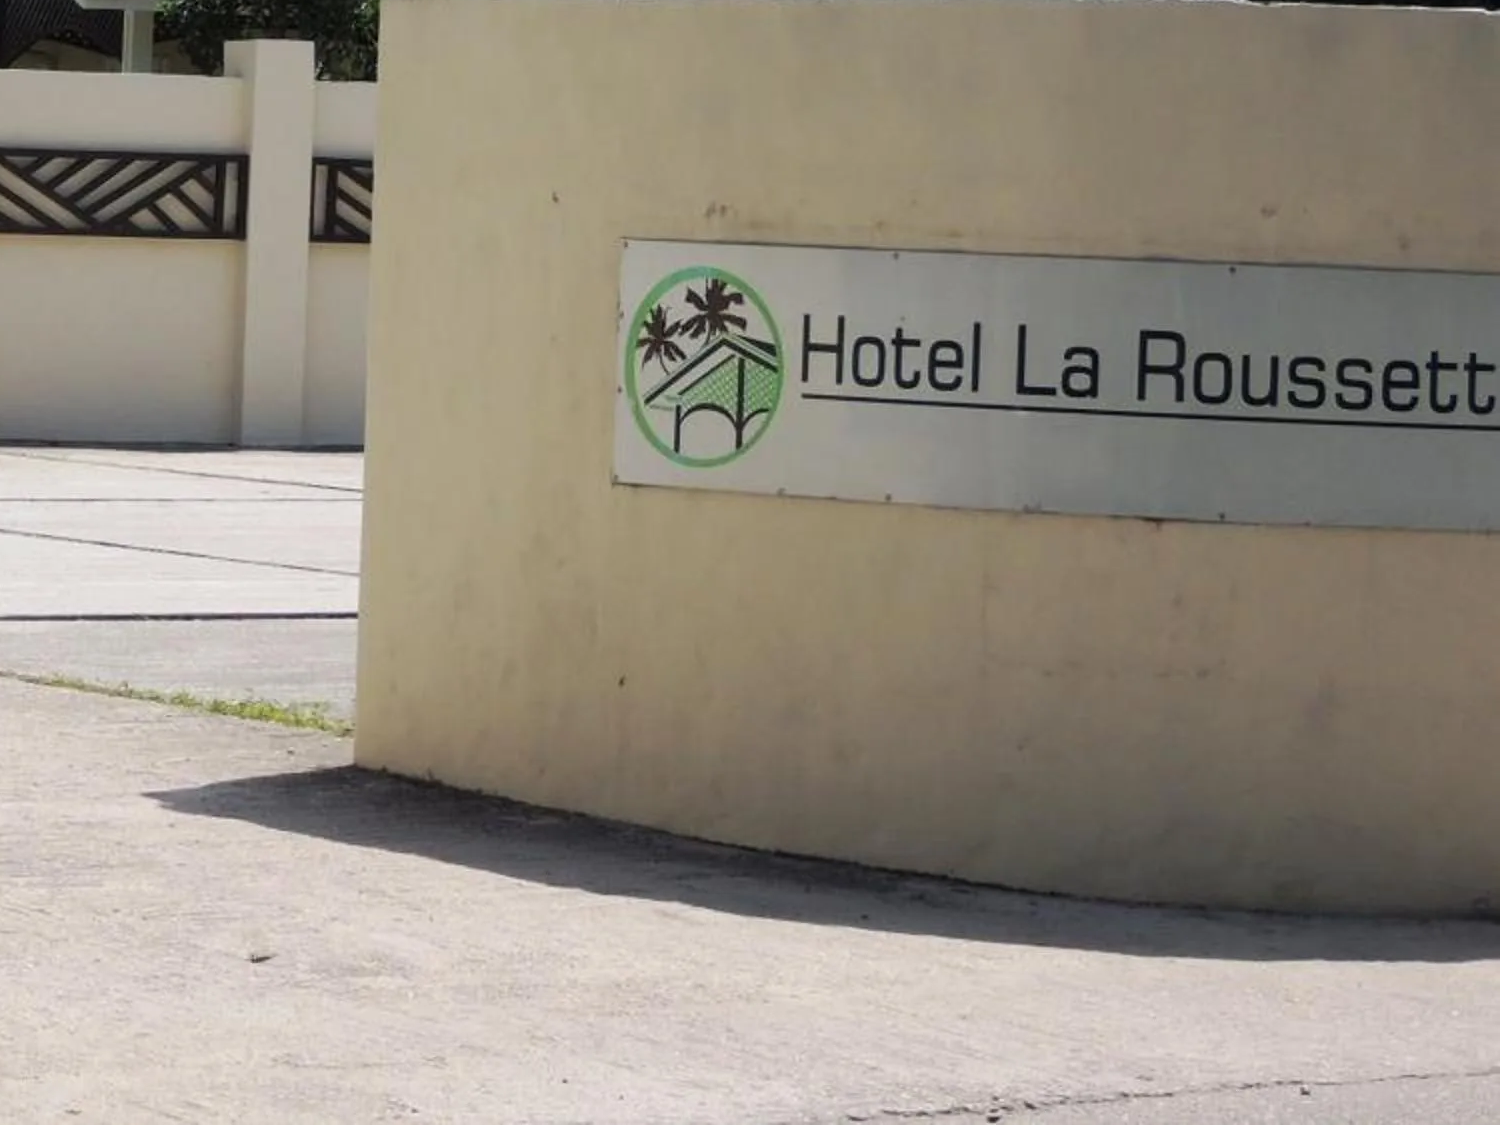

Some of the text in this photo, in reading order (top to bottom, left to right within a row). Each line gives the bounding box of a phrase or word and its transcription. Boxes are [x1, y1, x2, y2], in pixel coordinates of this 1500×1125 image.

[801, 314, 1497, 415] Hotel La Roussett
